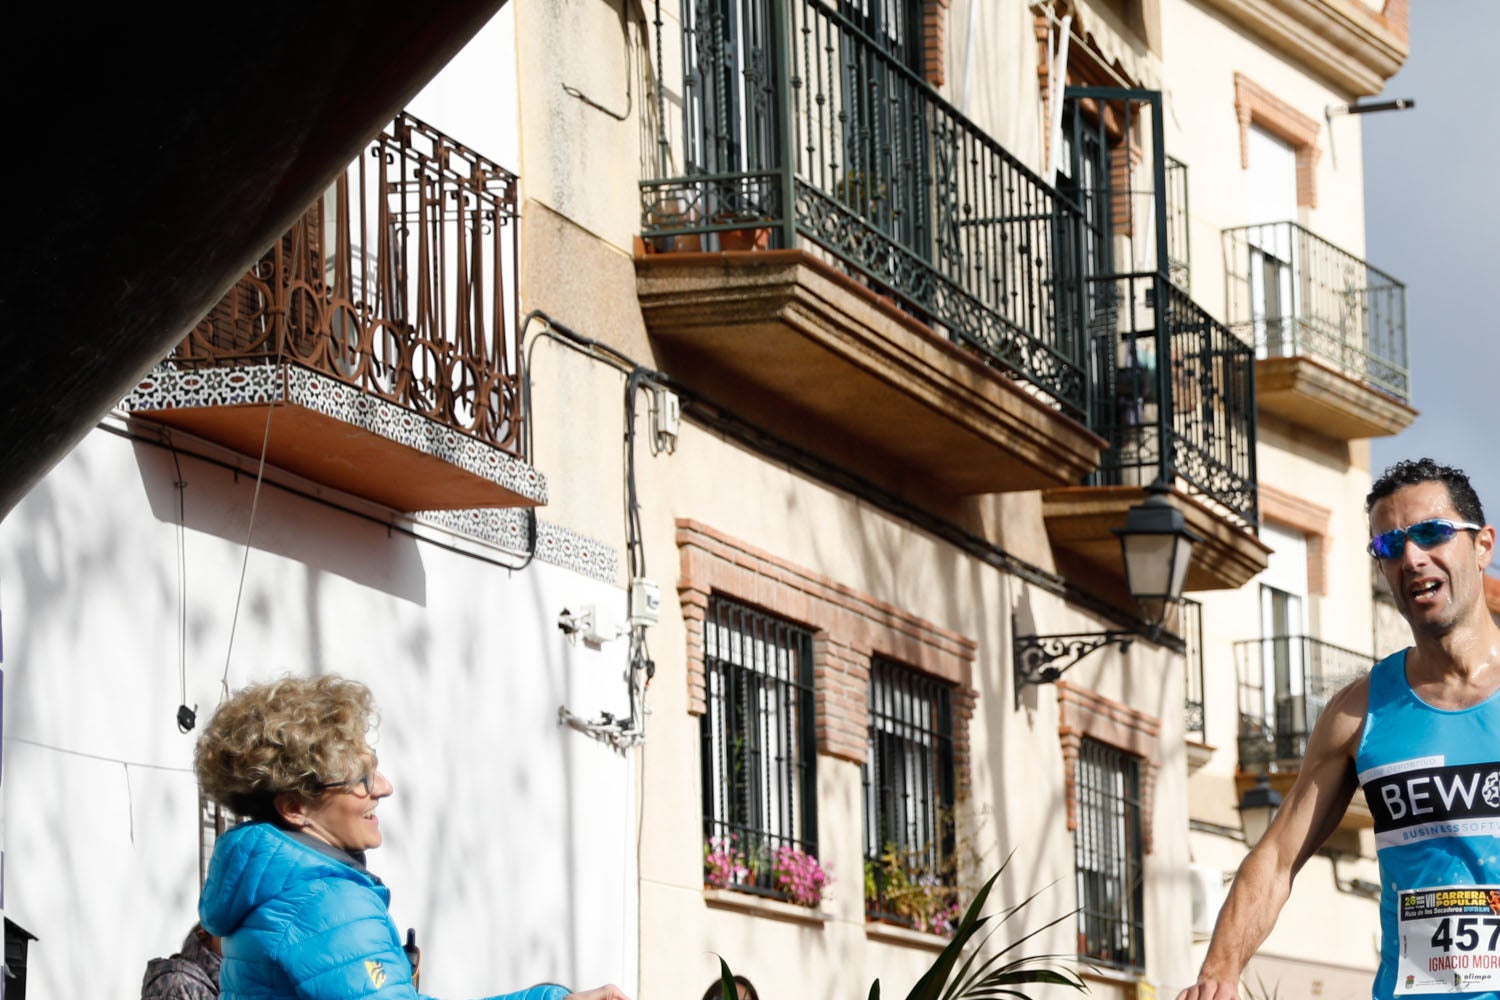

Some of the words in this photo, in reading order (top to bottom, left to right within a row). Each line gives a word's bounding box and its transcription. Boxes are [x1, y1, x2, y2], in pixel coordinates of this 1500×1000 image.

[1403, 824, 1460, 841] BUSINESS
[1436, 890, 1487, 900] CARRERA
[1436, 899, 1487, 907] POPULAR
[1429, 955, 1468, 972] IGNACIO
[1464, 973, 1492, 981] olimpo
